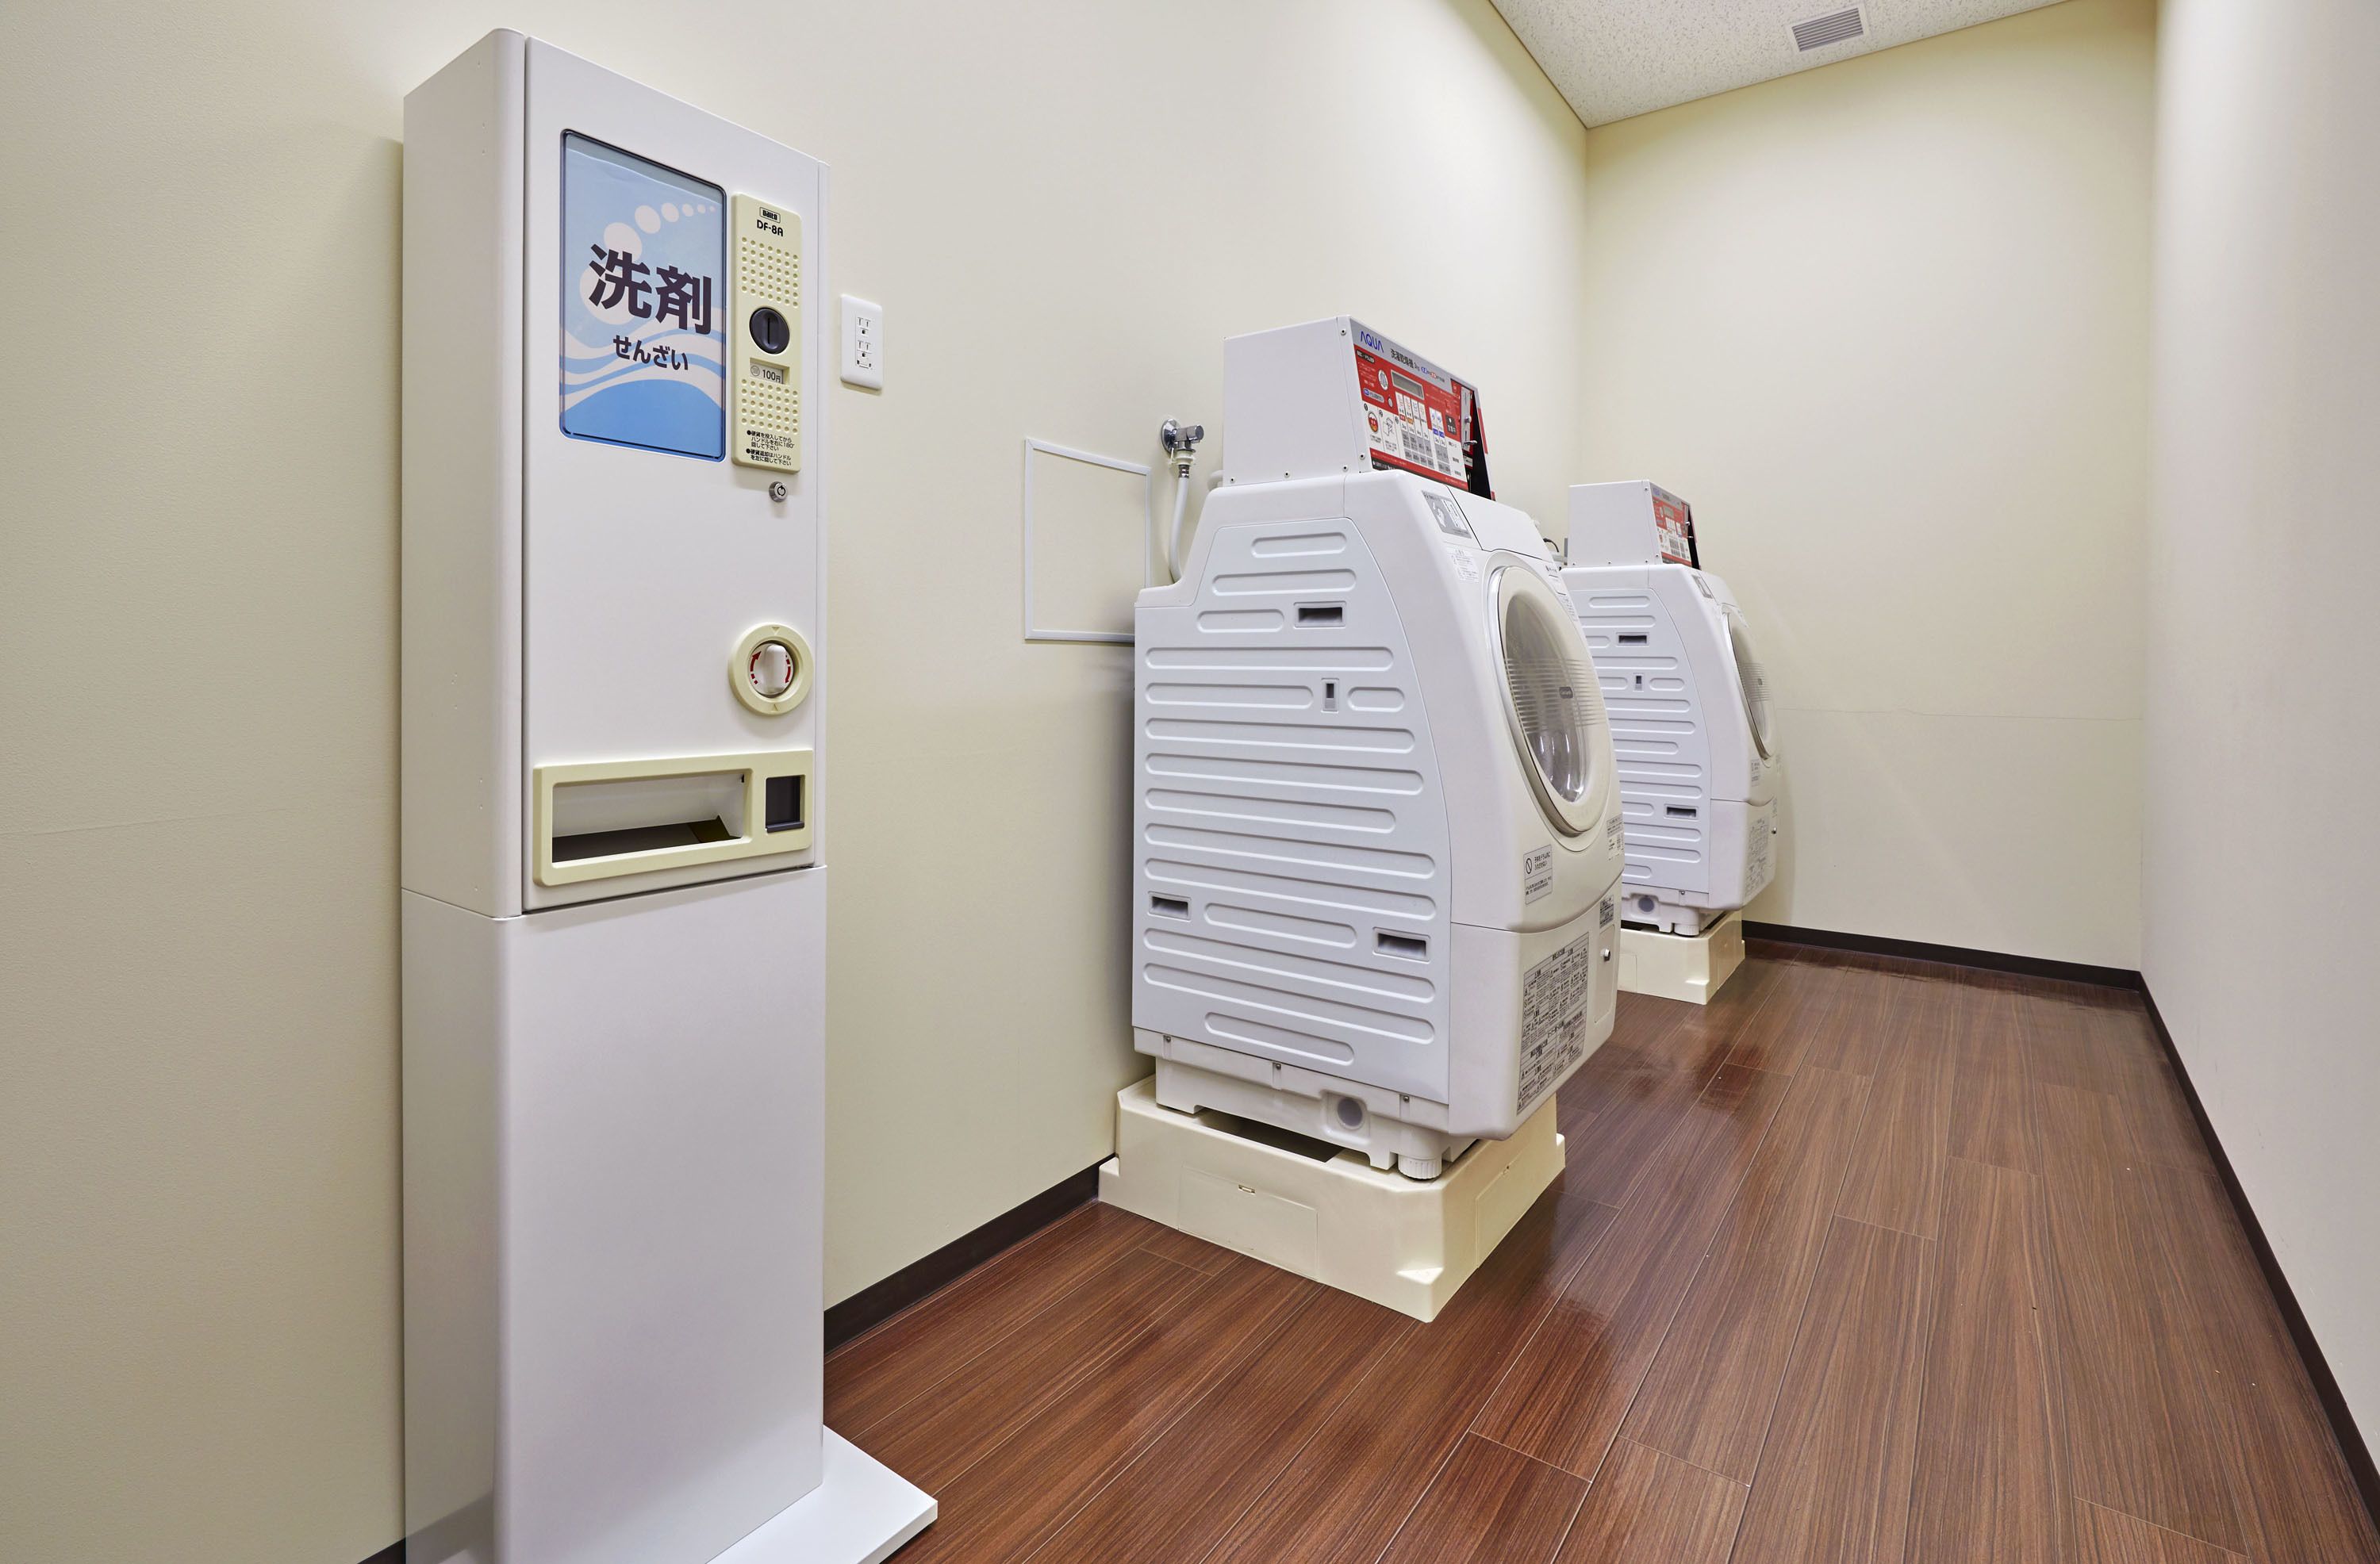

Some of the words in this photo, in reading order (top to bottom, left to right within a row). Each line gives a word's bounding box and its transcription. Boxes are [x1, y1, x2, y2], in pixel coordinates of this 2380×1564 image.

[757, 219, 783, 237] DF-8A
[589, 243, 712, 335] 洗剤
[613, 335, 688, 370] せんざい
[1361, 331, 1384, 353] AQUA
